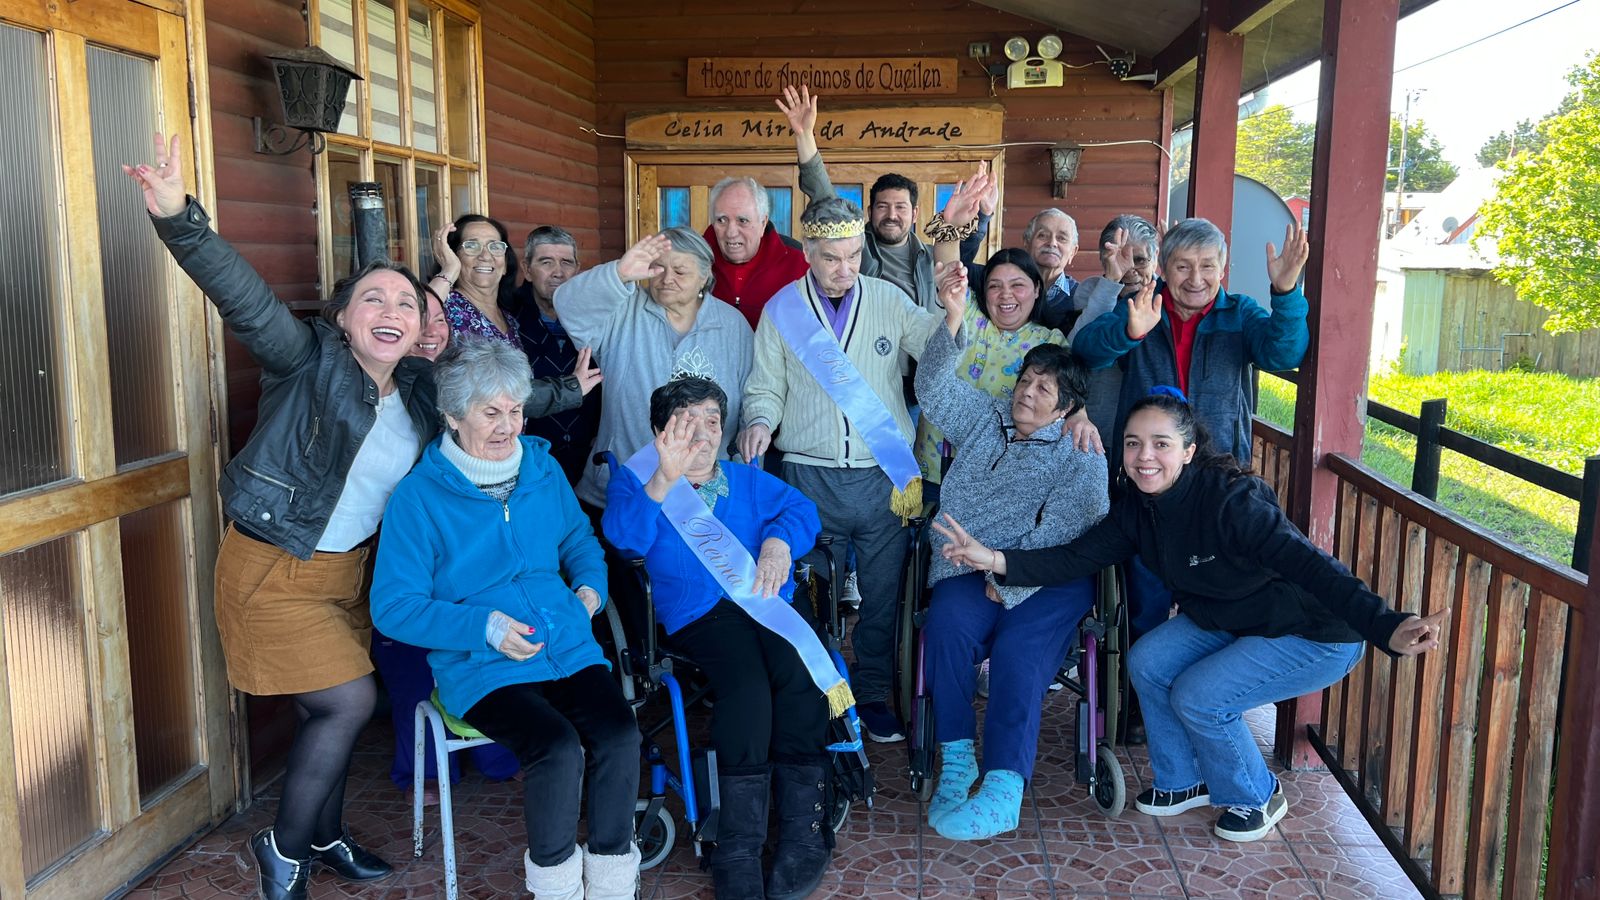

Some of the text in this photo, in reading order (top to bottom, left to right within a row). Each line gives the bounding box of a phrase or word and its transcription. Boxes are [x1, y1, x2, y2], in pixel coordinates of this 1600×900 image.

[701, 61, 941, 94] Hogar de Ancianos de Queilen
[665, 119, 962, 142] Celia Mirda Andrade
[816, 348, 850, 385] Rey
[680, 517, 744, 588] Reina
